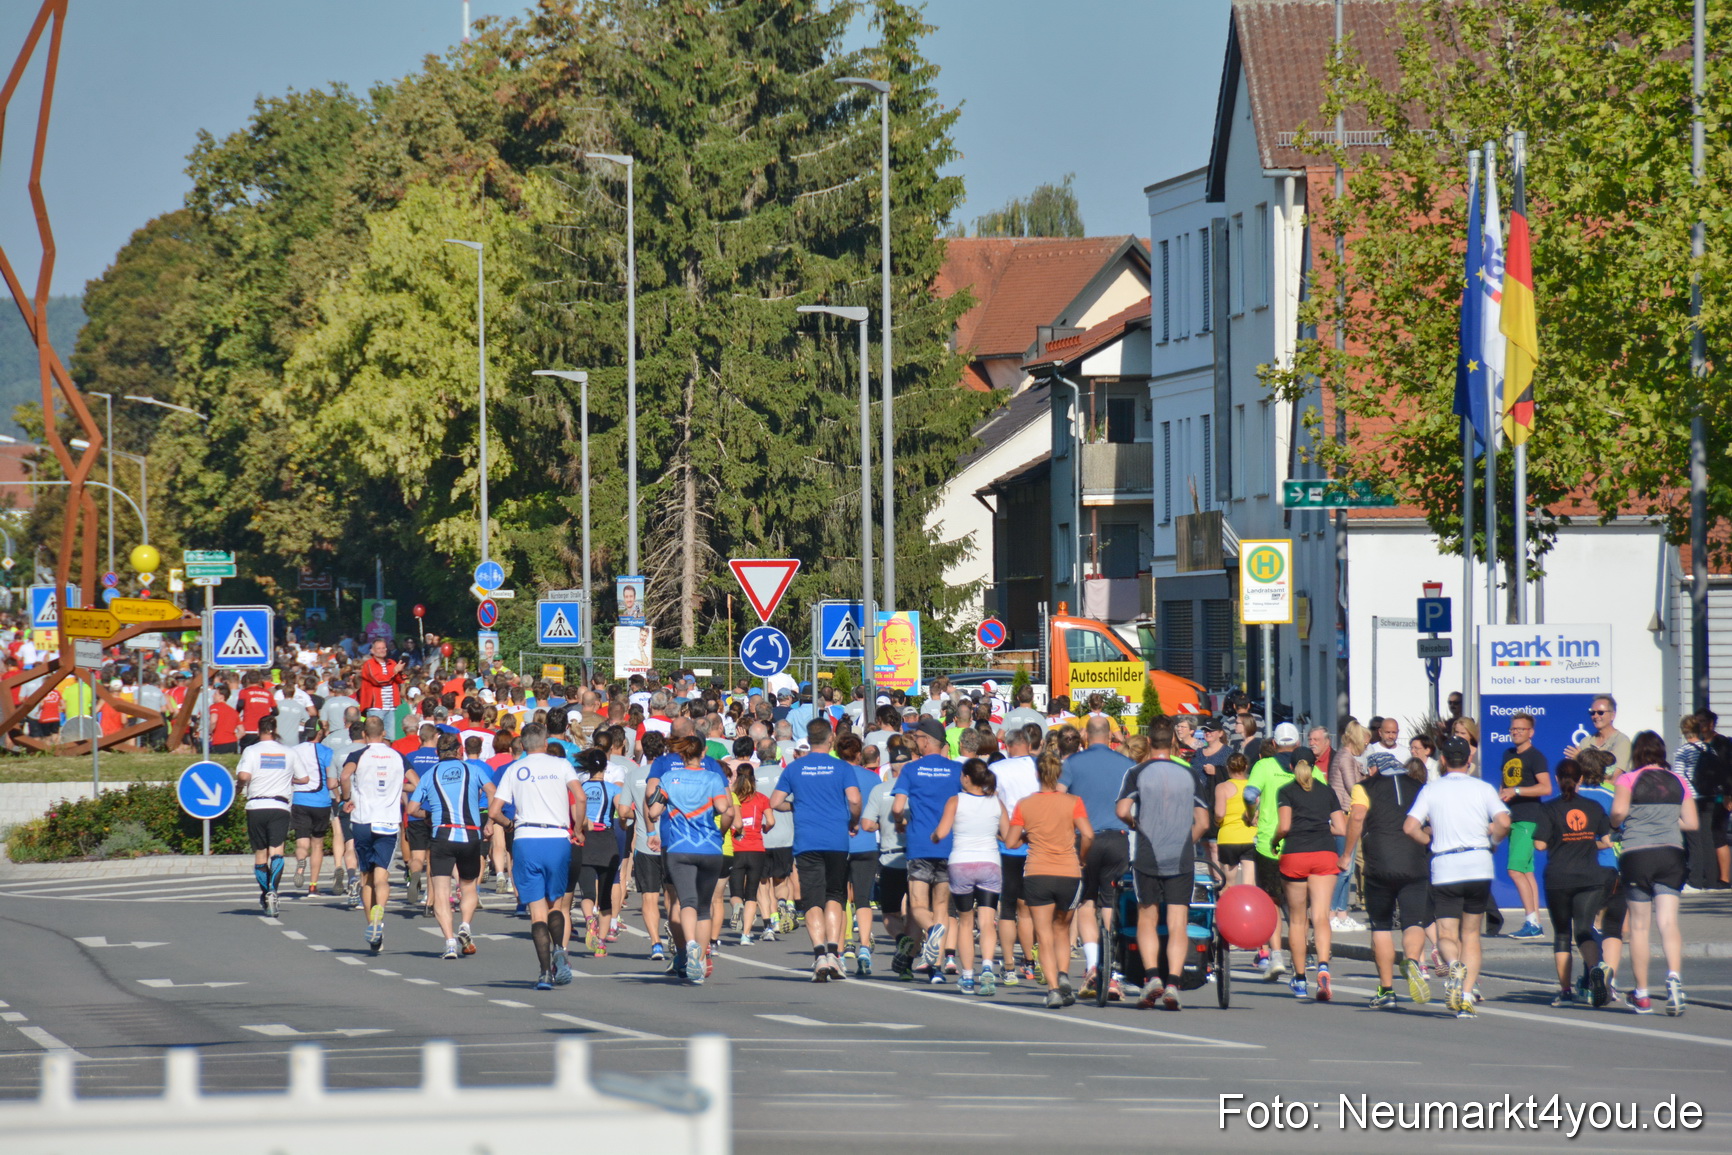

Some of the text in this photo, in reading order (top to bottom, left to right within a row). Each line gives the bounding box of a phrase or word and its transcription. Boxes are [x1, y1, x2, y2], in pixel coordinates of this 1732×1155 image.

[115, 604, 166, 620] Umleitung
[1425, 602, 1444, 628] P
[65, 614, 111, 634] Umleitung
[1420, 644, 1450, 653] Reisebus
[1491, 635, 1600, 666] park inn
[1566, 659, 1600, 671] Radisson
[1070, 667, 1143, 682] Autoschilder
[1490, 705, 1545, 715] Reception
